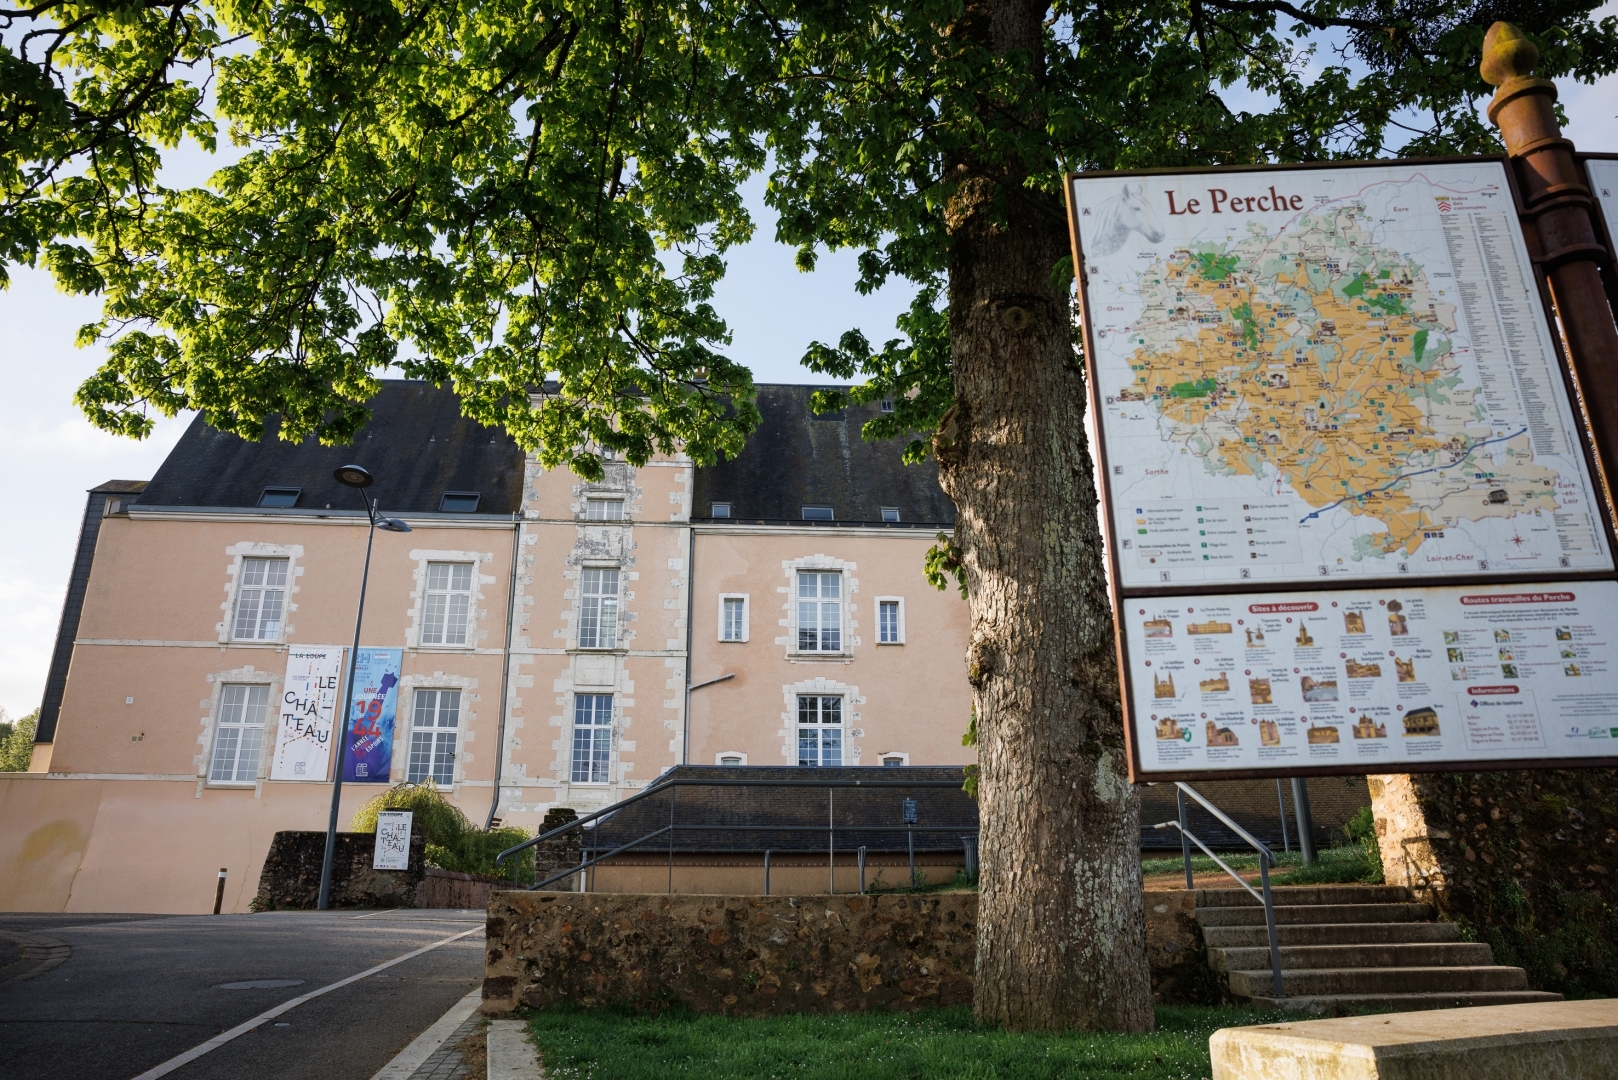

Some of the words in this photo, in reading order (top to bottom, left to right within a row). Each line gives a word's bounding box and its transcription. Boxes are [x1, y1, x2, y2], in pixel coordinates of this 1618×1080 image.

[1164, 191, 1201, 215] Le
[1207, 186, 1303, 213] Perche
[1115, 466, 1121, 474] E
[1124, 540, 1129, 548] F
[1426, 554, 1474, 562] Loir-et-Cher
[1400, 564, 1406, 572] 4
[1480, 562, 1486, 570] 5
[1242, 570, 1248, 578] 2
[1320, 567, 1327, 575] 3
[1491, 595, 1531, 603] tranquilles
[319, 676, 336, 689] LE
[356, 700, 382, 721] 19
[283, 714, 330, 743] TEAU
[353, 718, 382, 738] 44
[351, 735, 369, 751] L'ANNÉE
[366, 736, 384, 752] ESPOIRS
